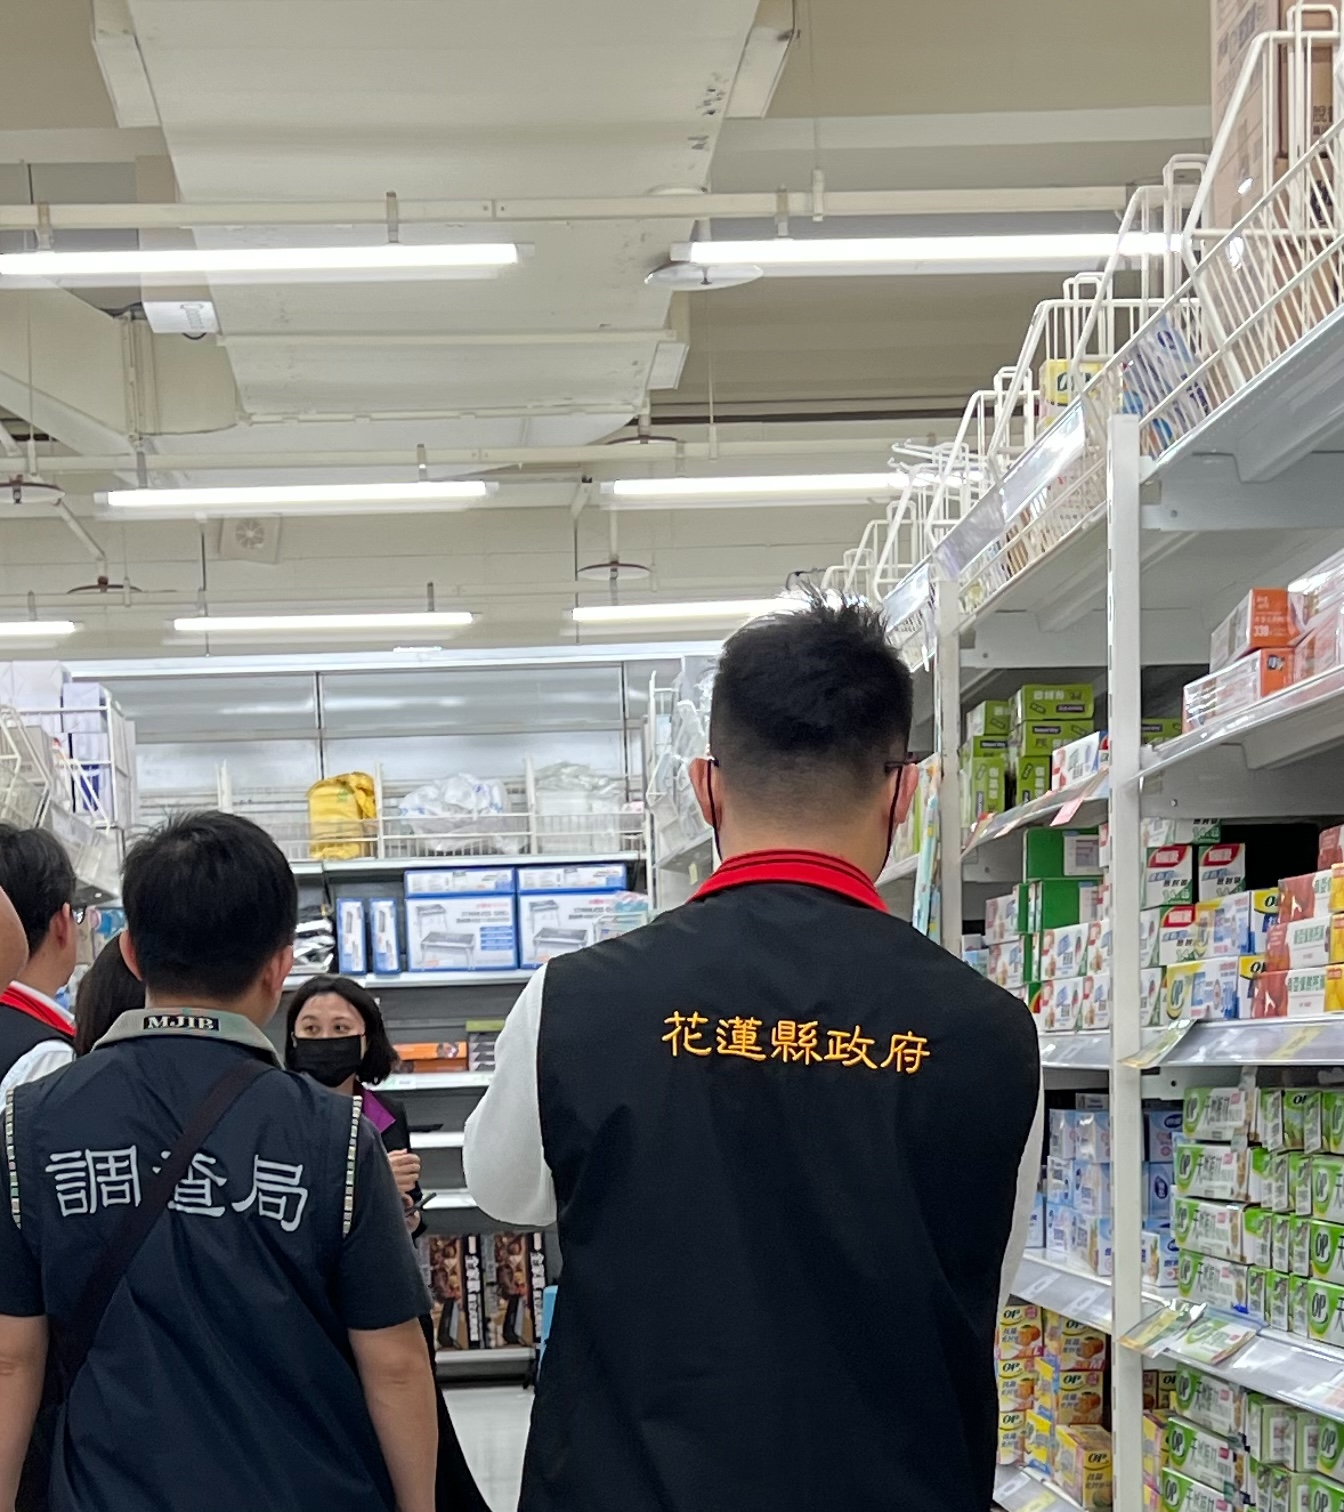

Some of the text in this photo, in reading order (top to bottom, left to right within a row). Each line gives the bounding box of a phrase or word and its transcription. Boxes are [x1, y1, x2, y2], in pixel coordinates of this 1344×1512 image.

[661, 1010, 931, 1074] 花蓮縣政府
[45, 1144, 308, 1232] 調查局
